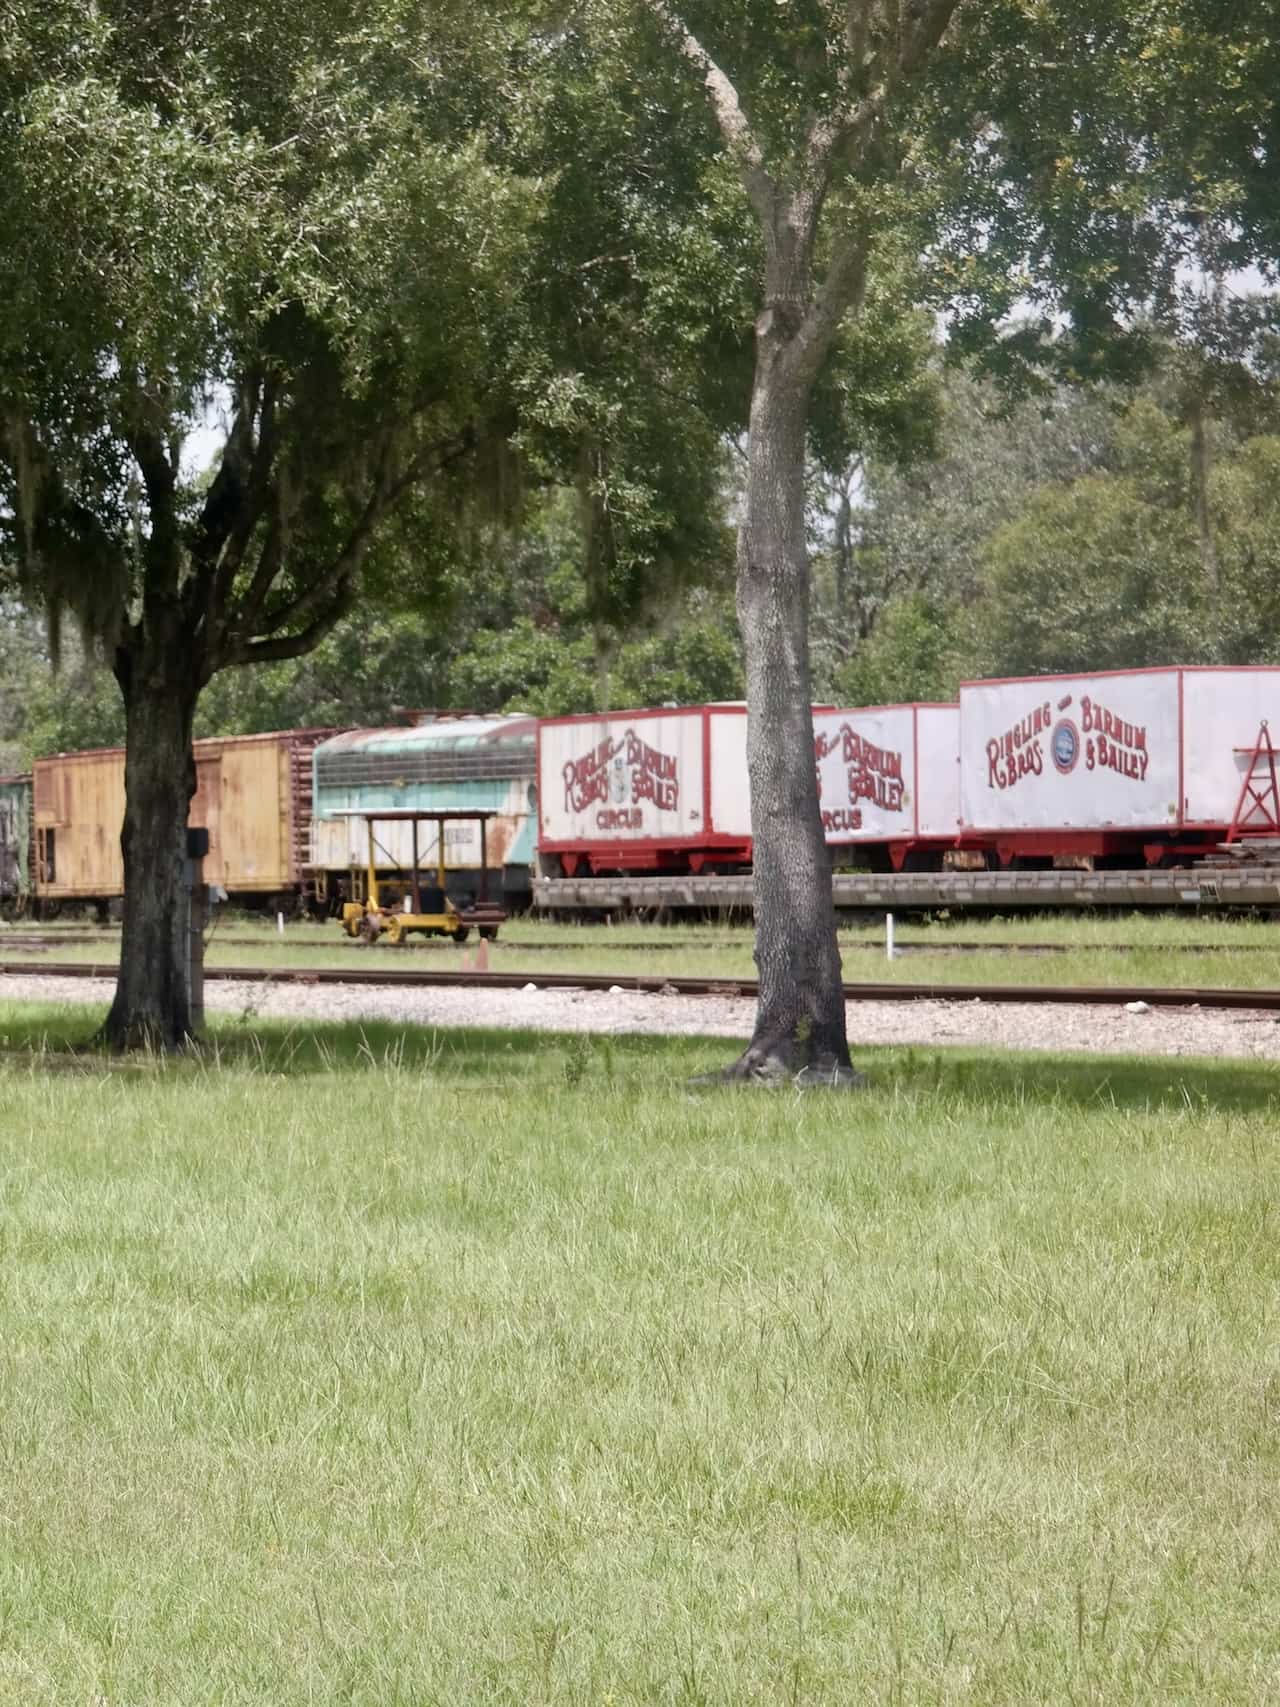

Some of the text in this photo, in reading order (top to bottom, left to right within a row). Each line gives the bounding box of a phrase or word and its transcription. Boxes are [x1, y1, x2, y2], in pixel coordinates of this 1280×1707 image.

[986, 695, 1147, 790] RINGLING BARNUM
[1096, 734, 1149, 781] BAILEY
[596, 808, 643, 830] CIRCUS
[821, 808, 862, 832] RCUS
